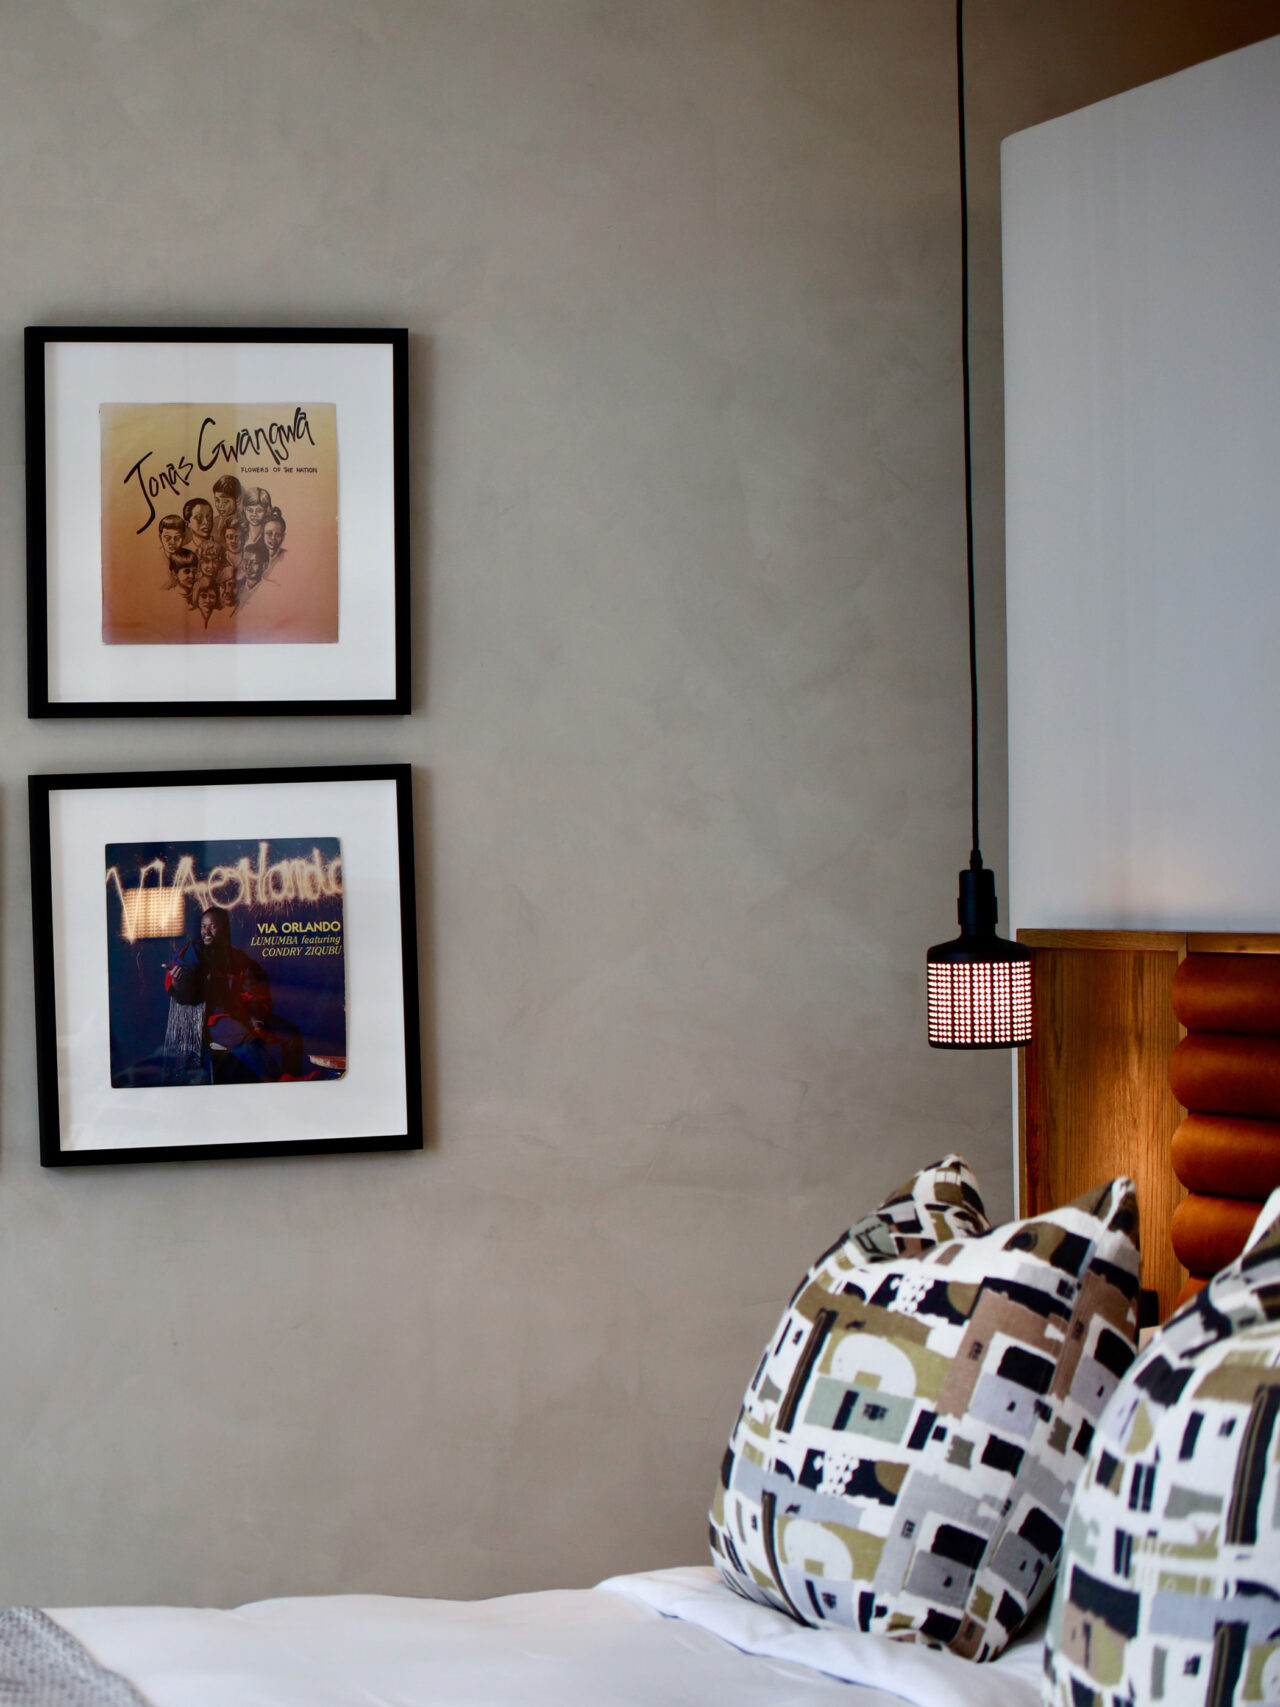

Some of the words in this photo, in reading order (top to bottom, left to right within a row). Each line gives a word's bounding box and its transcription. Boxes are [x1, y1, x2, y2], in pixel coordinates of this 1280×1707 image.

[123, 451, 194, 535] Jonas
[197, 407, 316, 471] Gwangwa
[256, 922, 278, 934] VIA
[281, 921, 342, 933] ORLANDO
[250, 936, 298, 947] LUMUMBA
[301, 935, 342, 947] featuring
[261, 947, 302, 957] CONDRY
[304, 945, 343, 956] ZIQUBU
